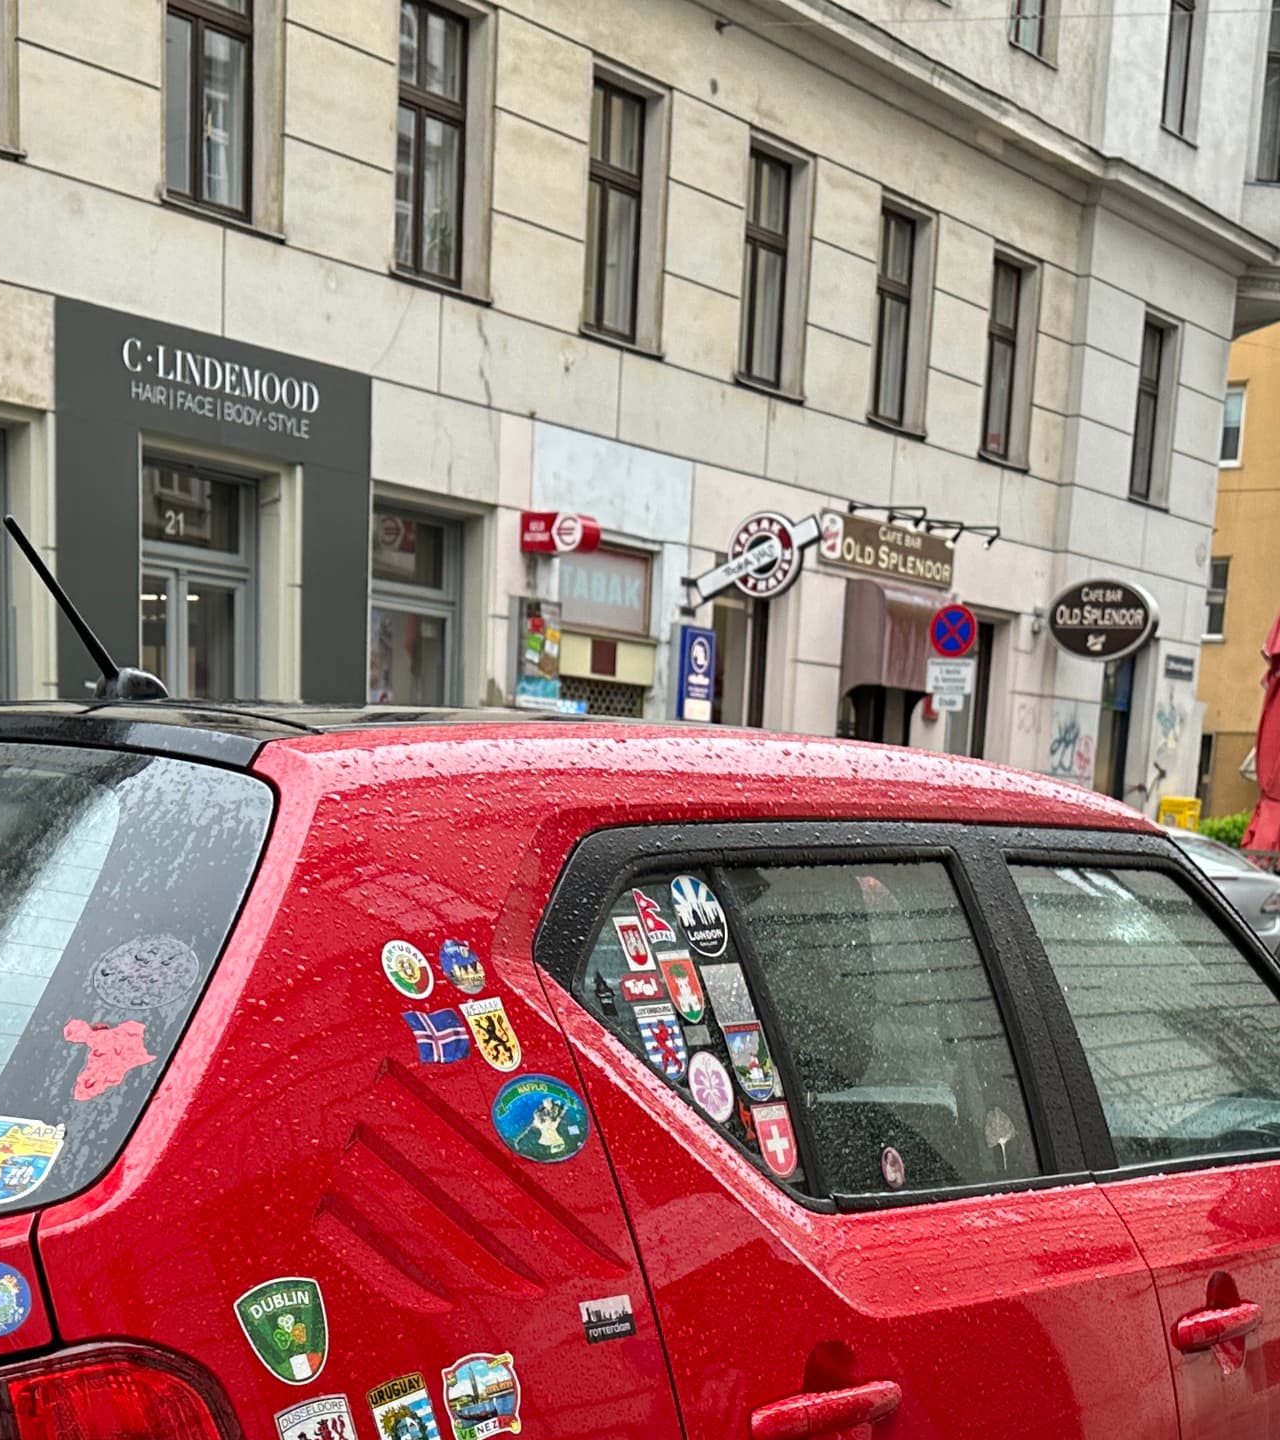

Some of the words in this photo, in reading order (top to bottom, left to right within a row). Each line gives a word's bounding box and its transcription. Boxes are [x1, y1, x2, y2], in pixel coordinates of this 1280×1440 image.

[131, 380, 167, 406] HAIR
[177, 390, 215, 417] FACE
[165, 510, 184, 536] 21
[904, 532, 922, 549] BAR
[843, 537, 875, 566] OLD
[878, 547, 951, 582] SPLENDOR
[561, 564, 641, 609] TABAK
[1105, 589, 1123, 601] BAR
[1055, 604, 1082, 625] OLD
[1083, 605, 1145, 627] SPLENDOR
[687, 929, 724, 941] LONDON
[387, 945, 424, 970] PORTUGAL
[21, 1124, 65, 1140] CAPE
[250, 1290, 310, 1319] DUBLIN
[370, 1375, 422, 1405] URUGUAY
